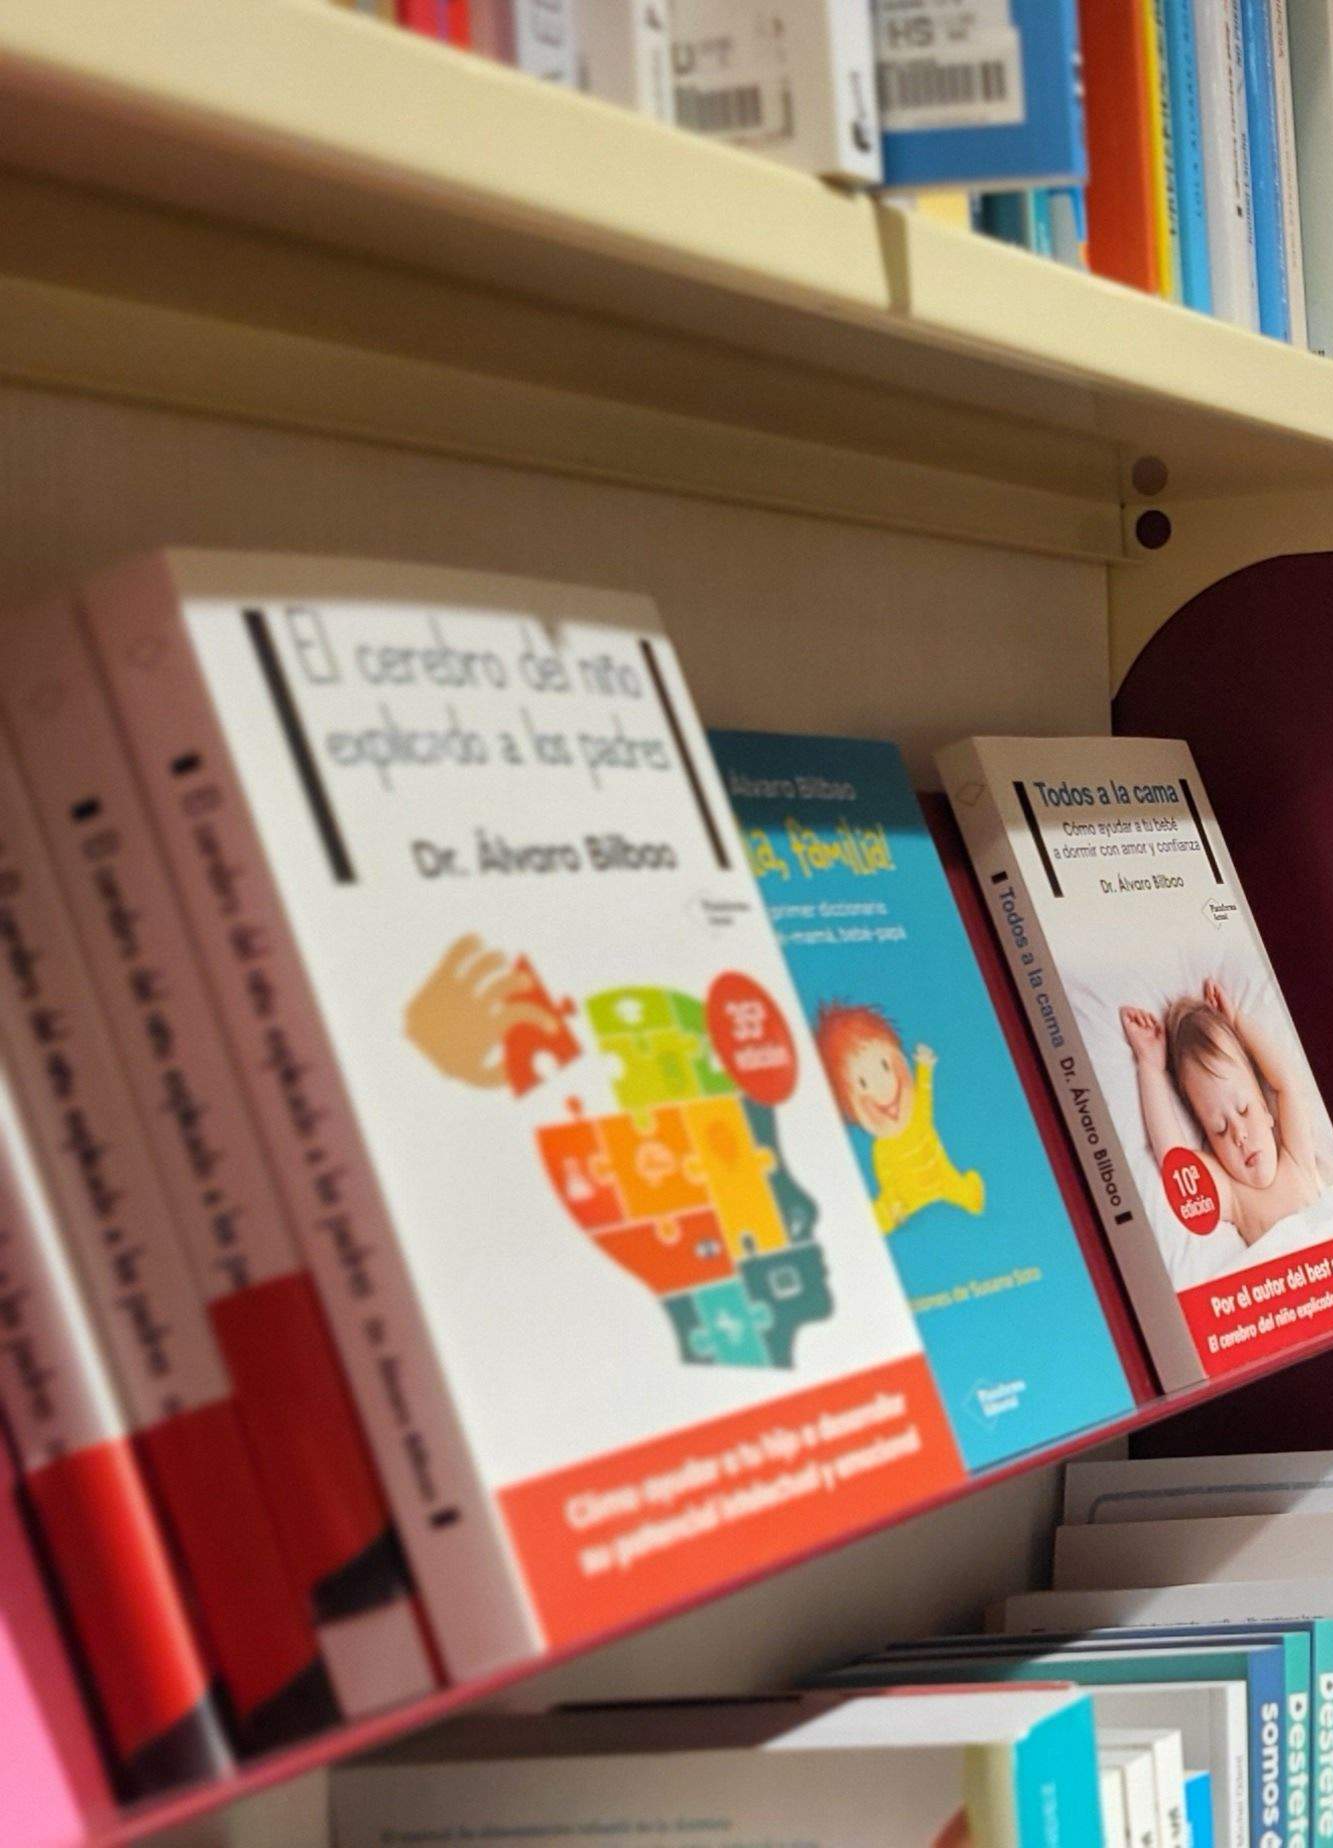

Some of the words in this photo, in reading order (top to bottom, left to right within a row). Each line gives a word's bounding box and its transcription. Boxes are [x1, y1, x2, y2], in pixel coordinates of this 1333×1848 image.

[286, 606, 340, 685] El
[354, 612, 510, 690] cerebro
[516, 620, 573, 694] del
[579, 650, 645, 700] niño
[326, 701, 489, 794] explicado
[498, 733, 524, 767] a
[520, 706, 574, 767] los
[577, 712, 674, 791] padres
[1033, 780, 1095, 809] Todos
[1098, 786, 1111, 806] a
[1113, 780, 1132, 806] la
[1135, 781, 1180, 804] cama
[410, 836, 468, 880] Dr.
[475, 825, 581, 875] Álvaro
[583, 832, 679, 872] Bilbao
[1053, 847, 1062, 860] a
[1062, 841, 1098, 860] dormir
[1099, 843, 1121, 857] con
[1120, 840, 1147, 856] amor
[1146, 843, 1157, 857] y
[1155, 836, 1202, 855] confianza
[1062, 818, 1098, 838] Cómo
[1098, 819, 1135, 837] ayudar
[1135, 822, 1142, 833] a
[1143, 818, 1154, 833] tu
[1154, 816, 1180, 832] bebé
[1099, 876, 1117, 895] Dr.
[1118, 872, 1153, 893] Álvaro
[1152, 873, 1186, 890] Bilbao
[1000, 885, 1029, 952] Todos
[1020, 950, 1034, 967] a
[1027, 969, 1045, 991] la
[1035, 992, 1067, 1050] cama
[1059, 1055, 1078, 1082] Dr.
[1068, 1087, 1100, 1148] Álvaro
[1092, 1147, 1124, 1209] Bilbao
[1172, 1163, 1202, 1198] 10ª
[1178, 1194, 1217, 1221] edición
[1211, 1291, 1238, 1318] Por
[1239, 1286, 1252, 1309] el
[1252, 1276, 1287, 1303] autor
[1287, 1267, 1306, 1291] del
[1306, 1258, 1331, 1283] best
[1207, 1335, 1219, 1354] El
[1218, 1323, 1258, 1351] cerebro
[1258, 1314, 1275, 1335] del
[1275, 1306, 1297, 1328] niño
[1261, 1702, 1281, 1827] somos
[1287, 1692, 1311, 1848] Destete
